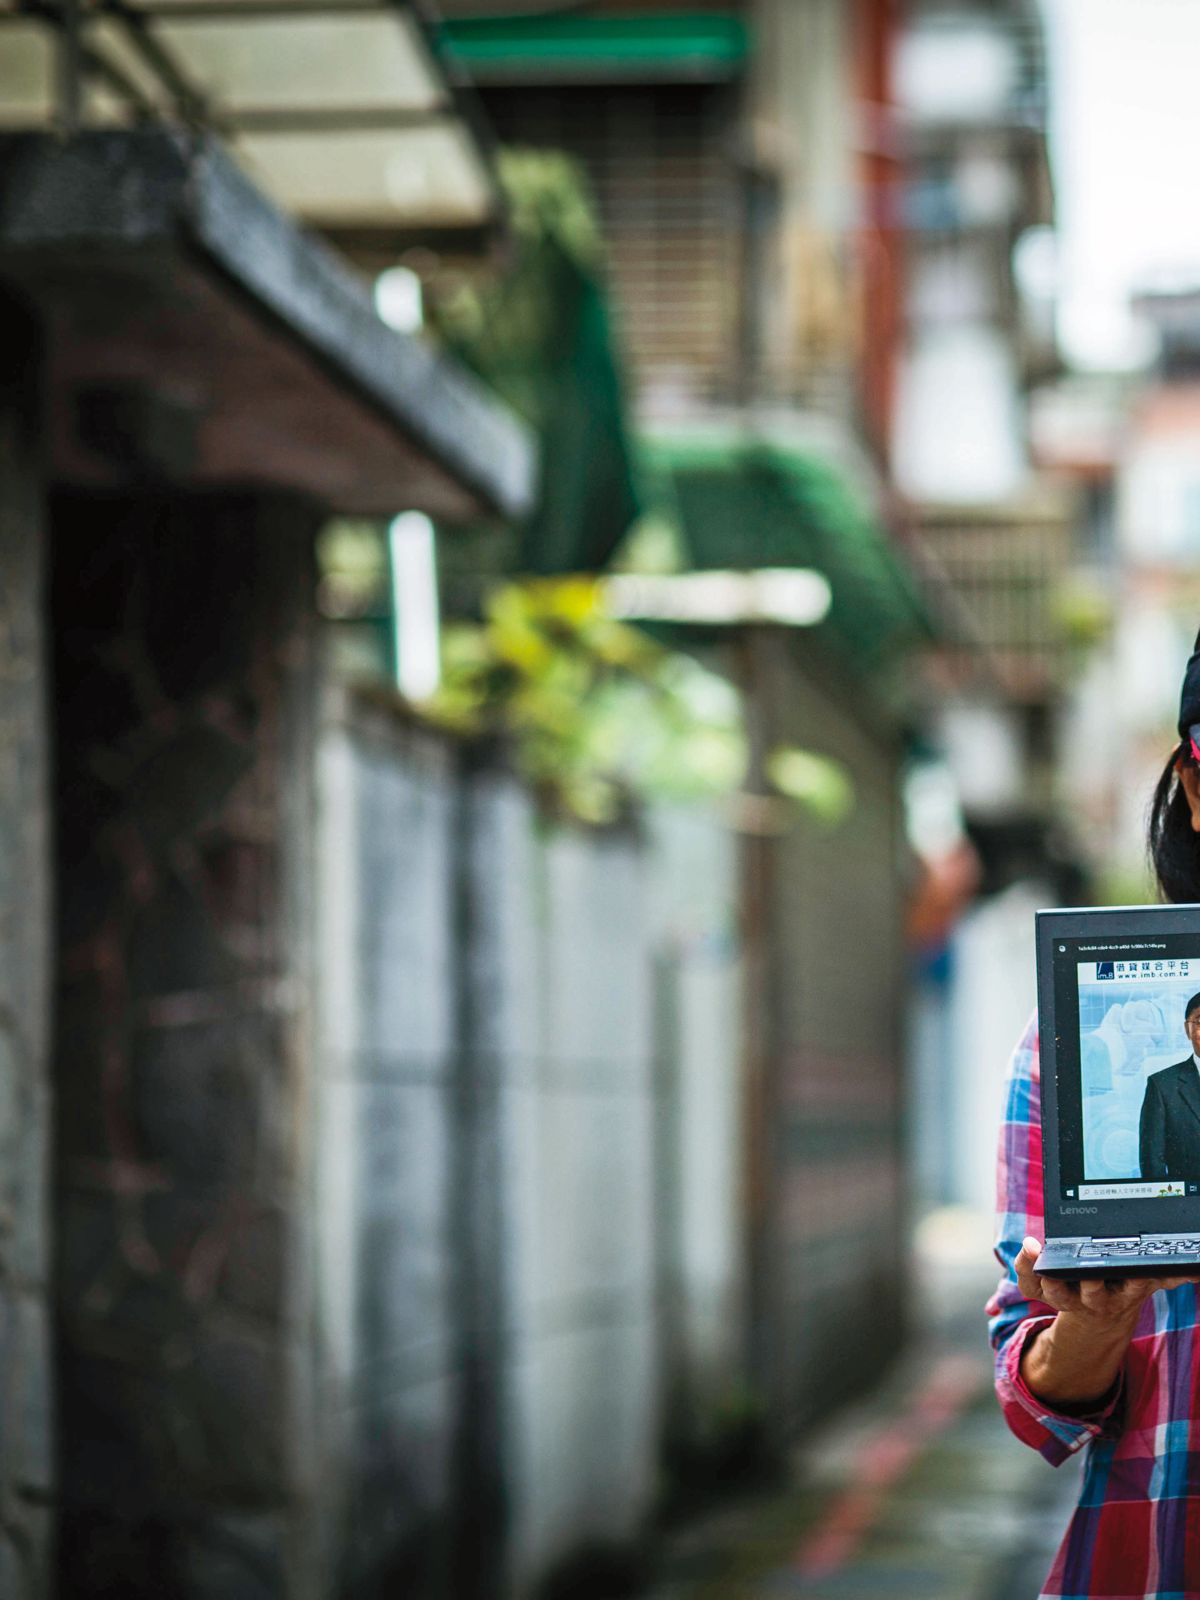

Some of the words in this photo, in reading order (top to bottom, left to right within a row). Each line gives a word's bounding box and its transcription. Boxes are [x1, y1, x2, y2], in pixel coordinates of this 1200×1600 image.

[1116, 960, 1189, 972] 借貸媒合平台
[1118, 971, 1189, 979] www.imb.com.tw
[1059, 1206, 1098, 1215] Lenovo
